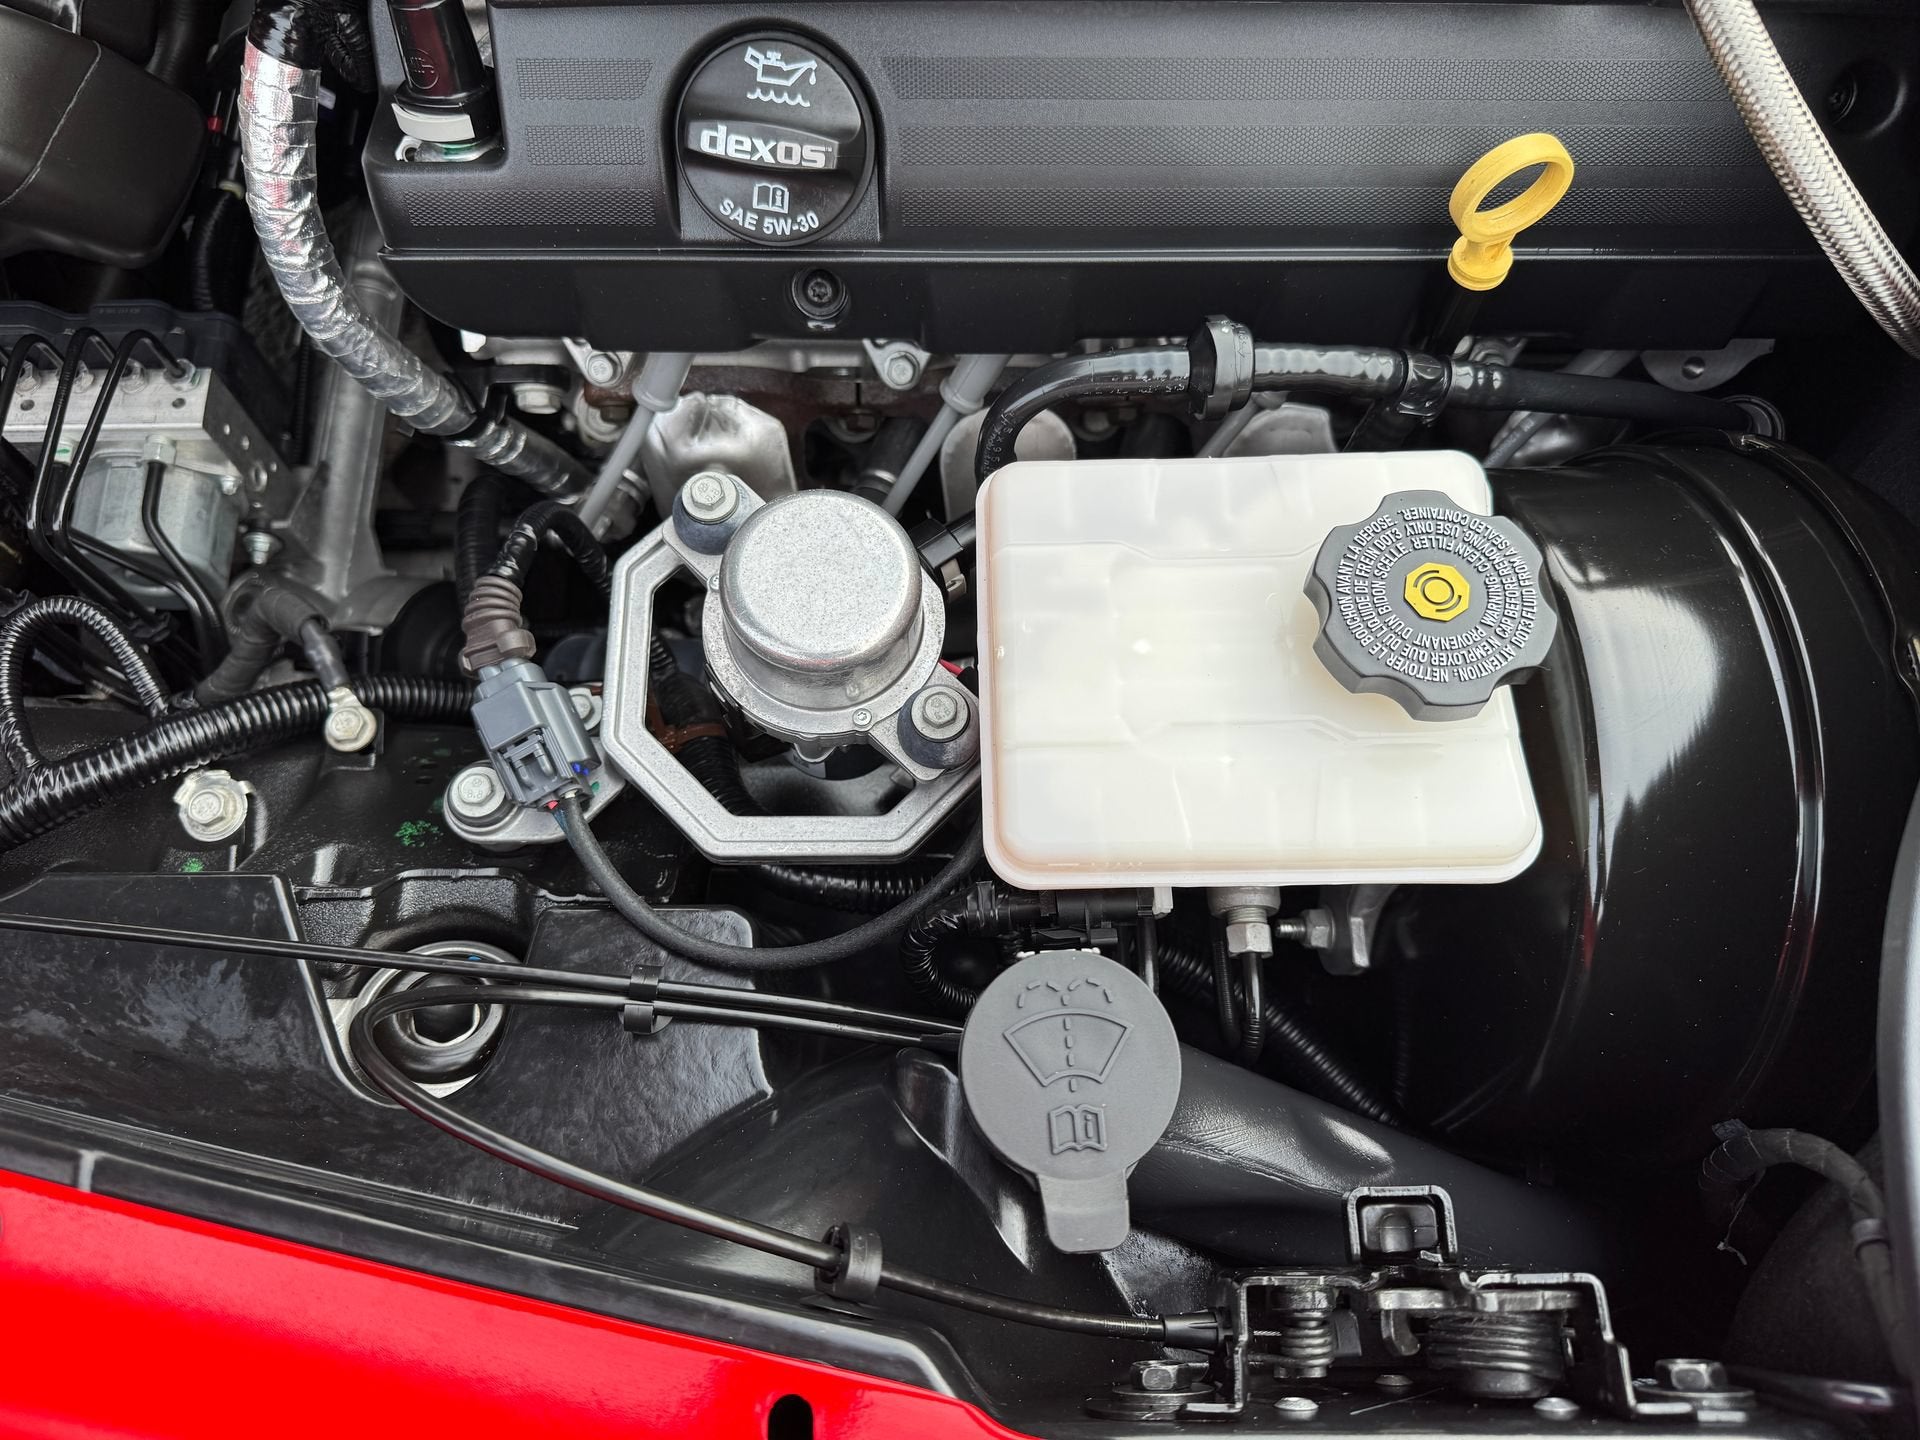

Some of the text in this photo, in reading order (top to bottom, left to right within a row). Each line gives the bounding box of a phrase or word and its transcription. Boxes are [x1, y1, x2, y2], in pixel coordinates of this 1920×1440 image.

[700, 123, 826, 168] dexos
[719, 198, 820, 236] SAE 5W-30
[1373, 527, 1403, 552] DOT3
[1405, 520, 1434, 537] ONLY
[1436, 522, 1460, 538] USE
[1469, 518, 1509, 550] SEALED
[1345, 544, 1362, 560] LA
[1355, 546, 1381, 578] FREIN
[1505, 547, 1518, 558] A
[1336, 559, 1354, 595] AVANT
[1412, 537, 1502, 627] WARNING: CLEAN FILLER
[1512, 555, 1534, 586] FROM
[1354, 579, 1369, 594] DE
[1371, 580, 1392, 615] BIDON
[1502, 577, 1520, 619] BEFORE
[1356, 595, 1388, 638] LIQUIDE
[1521, 588, 1537, 620] FLUID
[1338, 596, 1375, 647] BOUCHON
[1495, 617, 1514, 639] CAP
[1510, 619, 1534, 649] DOT3
[1368, 642, 1388, 660] LE
[1382, 633, 1402, 651] DU
[1401, 643, 1428, 663] QUE
[1413, 625, 1487, 651] PROVENANT
[1386, 653, 1449, 683] NETTOYER
[1453, 643, 1517, 681] ATTENTION:
